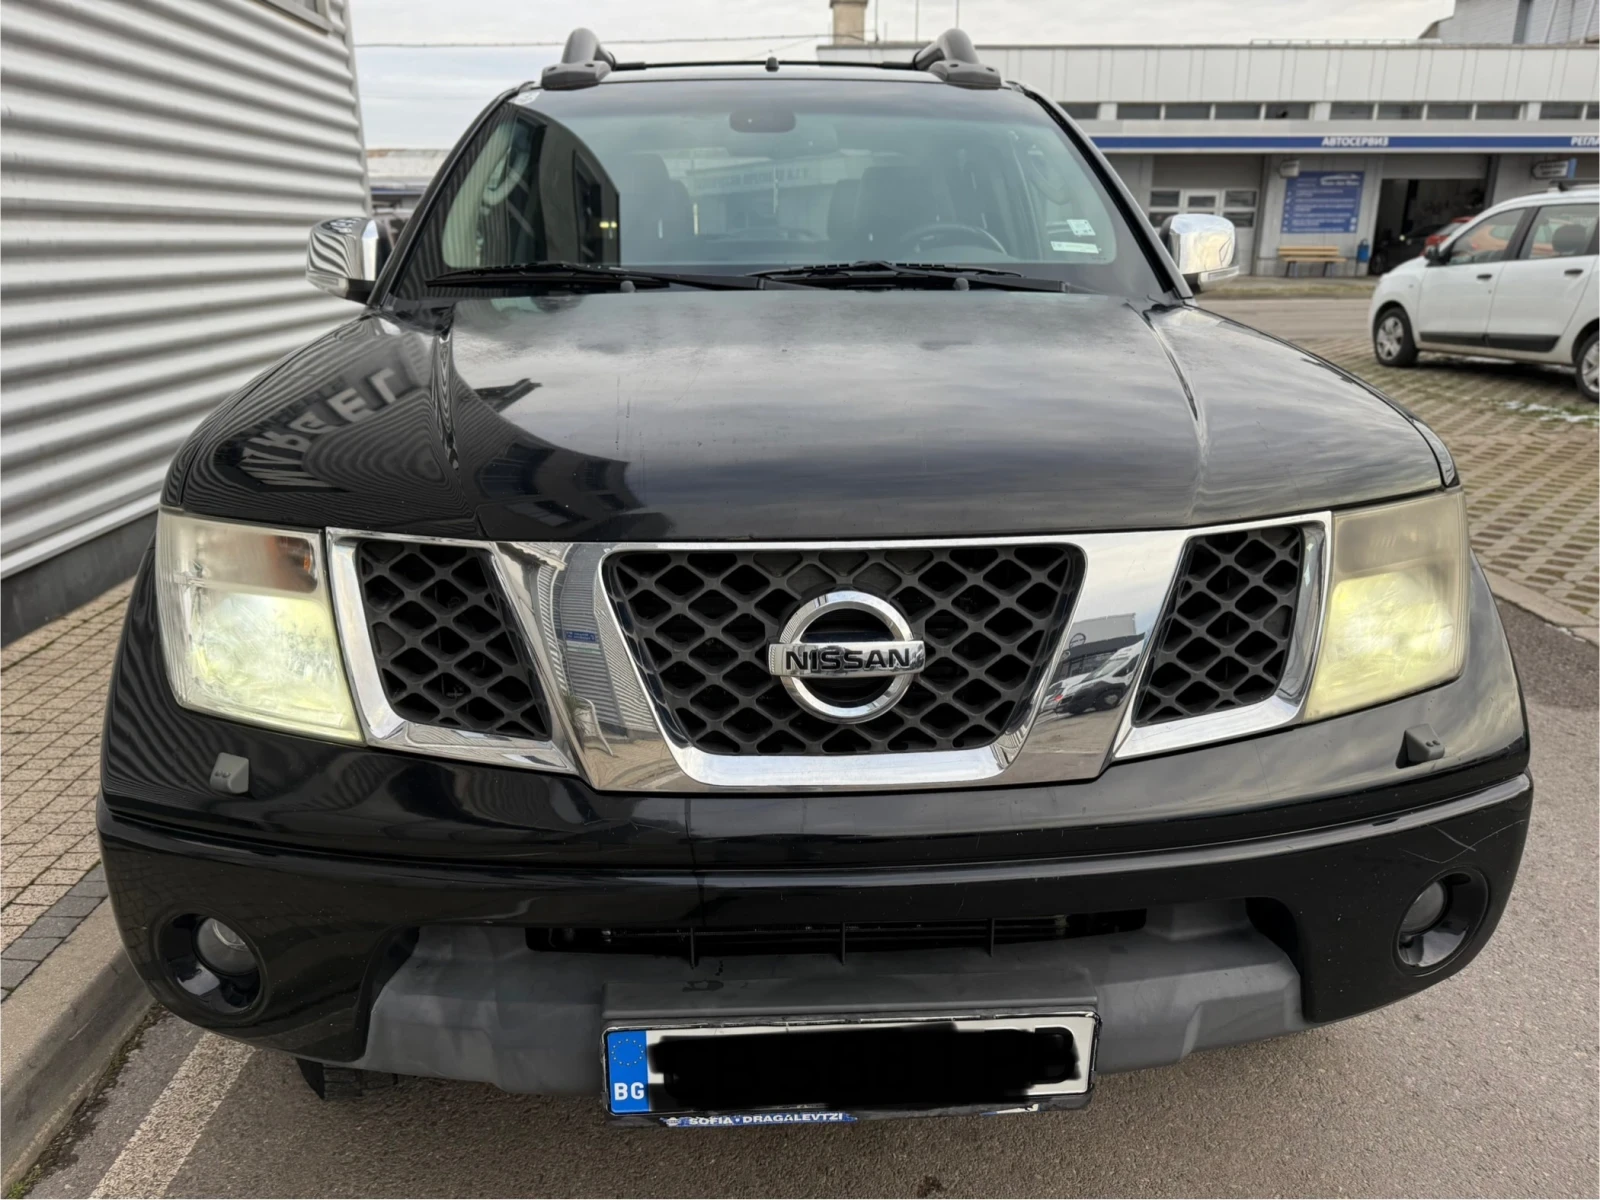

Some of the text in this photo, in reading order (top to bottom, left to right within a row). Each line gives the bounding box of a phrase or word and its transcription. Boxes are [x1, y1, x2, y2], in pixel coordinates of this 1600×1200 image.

[1321, 136, 1389, 147] АВТОСЕРВИЗ
[785, 648, 910, 671] NISSAN
[614, 1082, 644, 1100] BG
[689, 1116, 733, 1126] SOFIA
[743, 1112, 842, 1124] DRAGALEVTZI
